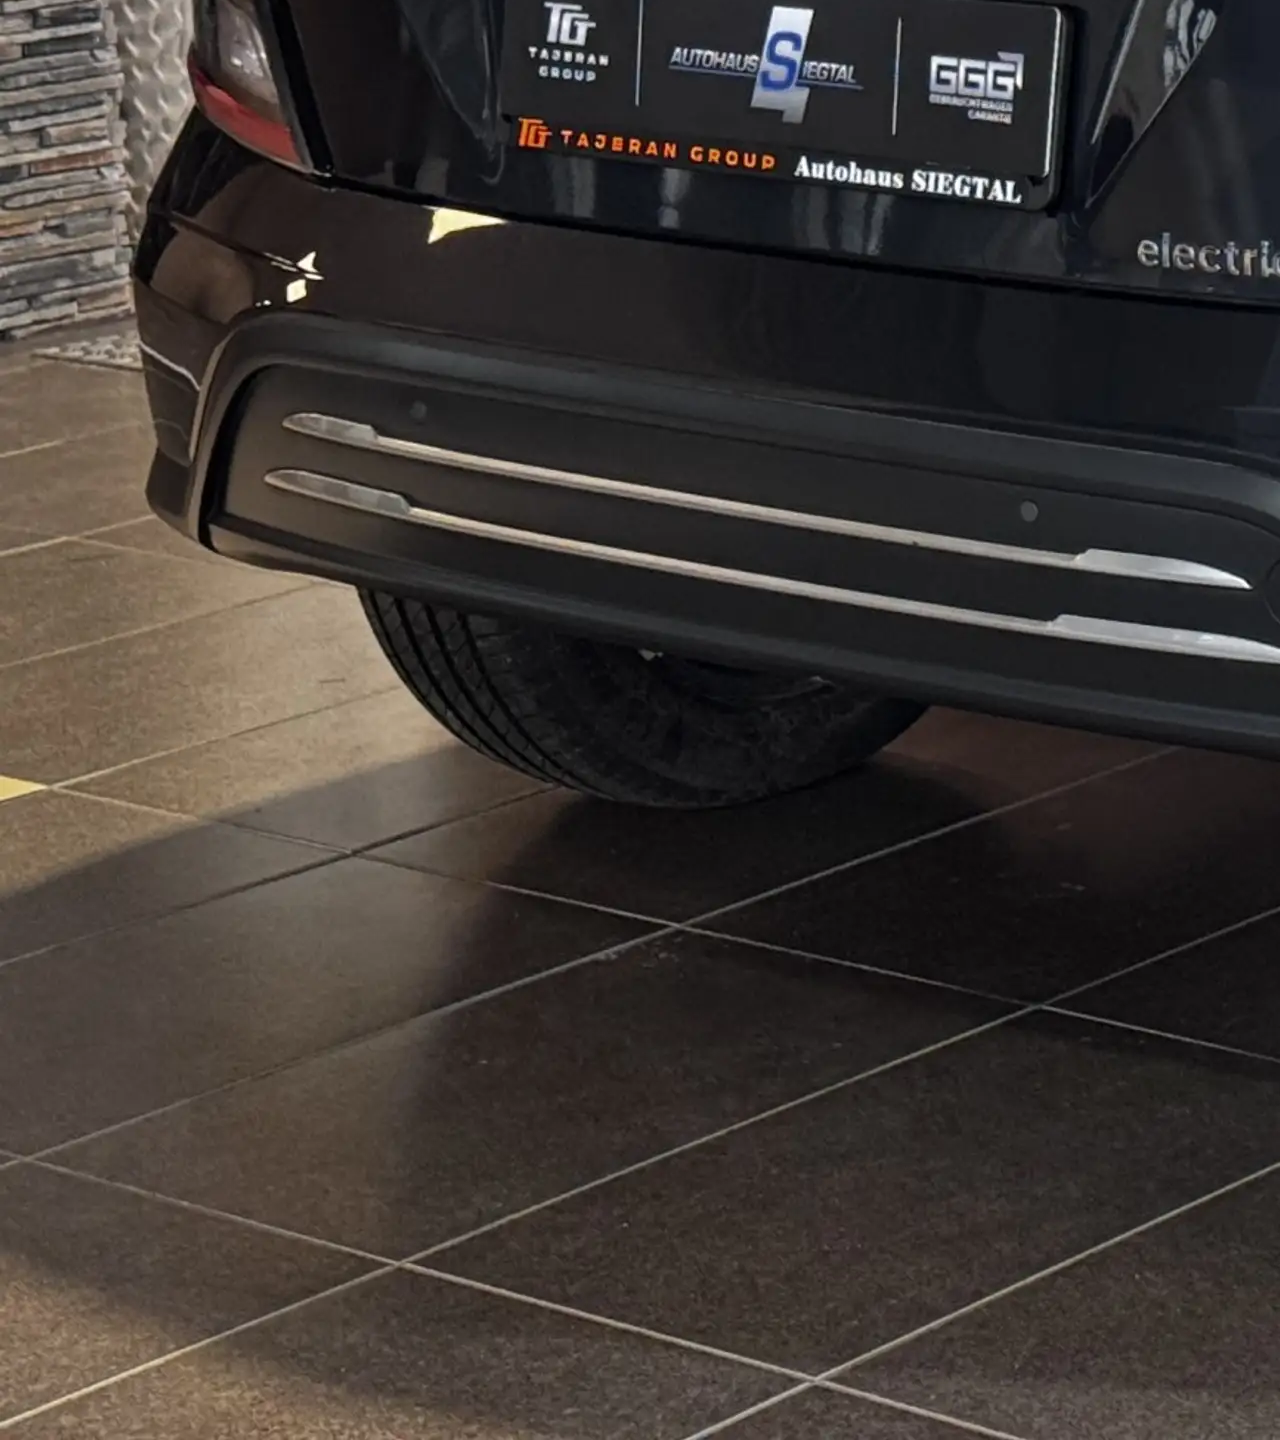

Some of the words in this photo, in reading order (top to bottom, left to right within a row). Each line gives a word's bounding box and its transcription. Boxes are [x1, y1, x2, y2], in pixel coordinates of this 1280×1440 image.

[538, 65, 597, 82] GROUP
[670, 47, 760, 73] AUTOHAUS
[560, 129, 677, 159] TAJERAN
[690, 146, 776, 171] GROUP
[794, 155, 904, 190] Autohaus
[911, 168, 1023, 205] SIEGTAL
